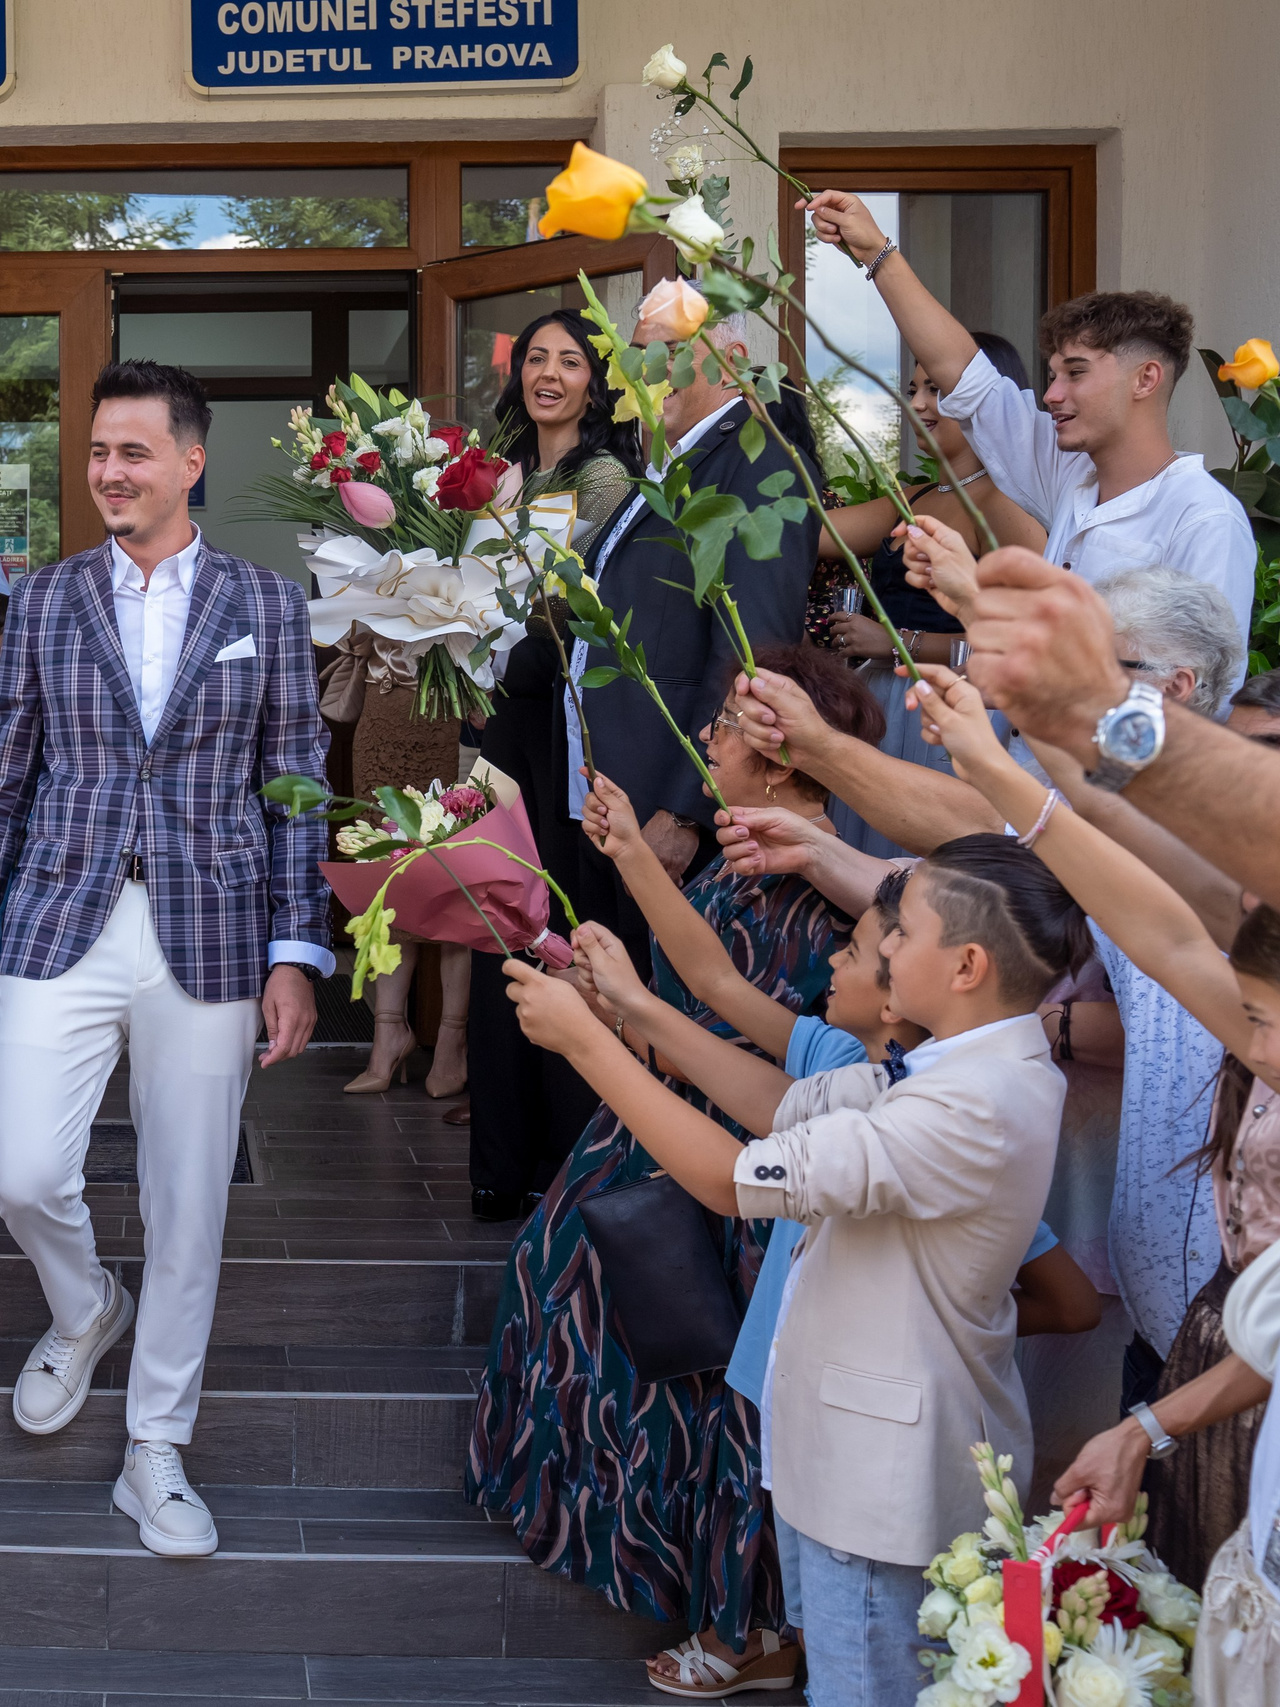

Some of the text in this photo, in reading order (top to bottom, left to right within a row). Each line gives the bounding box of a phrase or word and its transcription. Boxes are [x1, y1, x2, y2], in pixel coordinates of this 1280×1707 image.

[217, 0, 554, 35] COMUNEI STEFESTI
[217, 42, 553, 75] JUDETUL PRAHOVA
